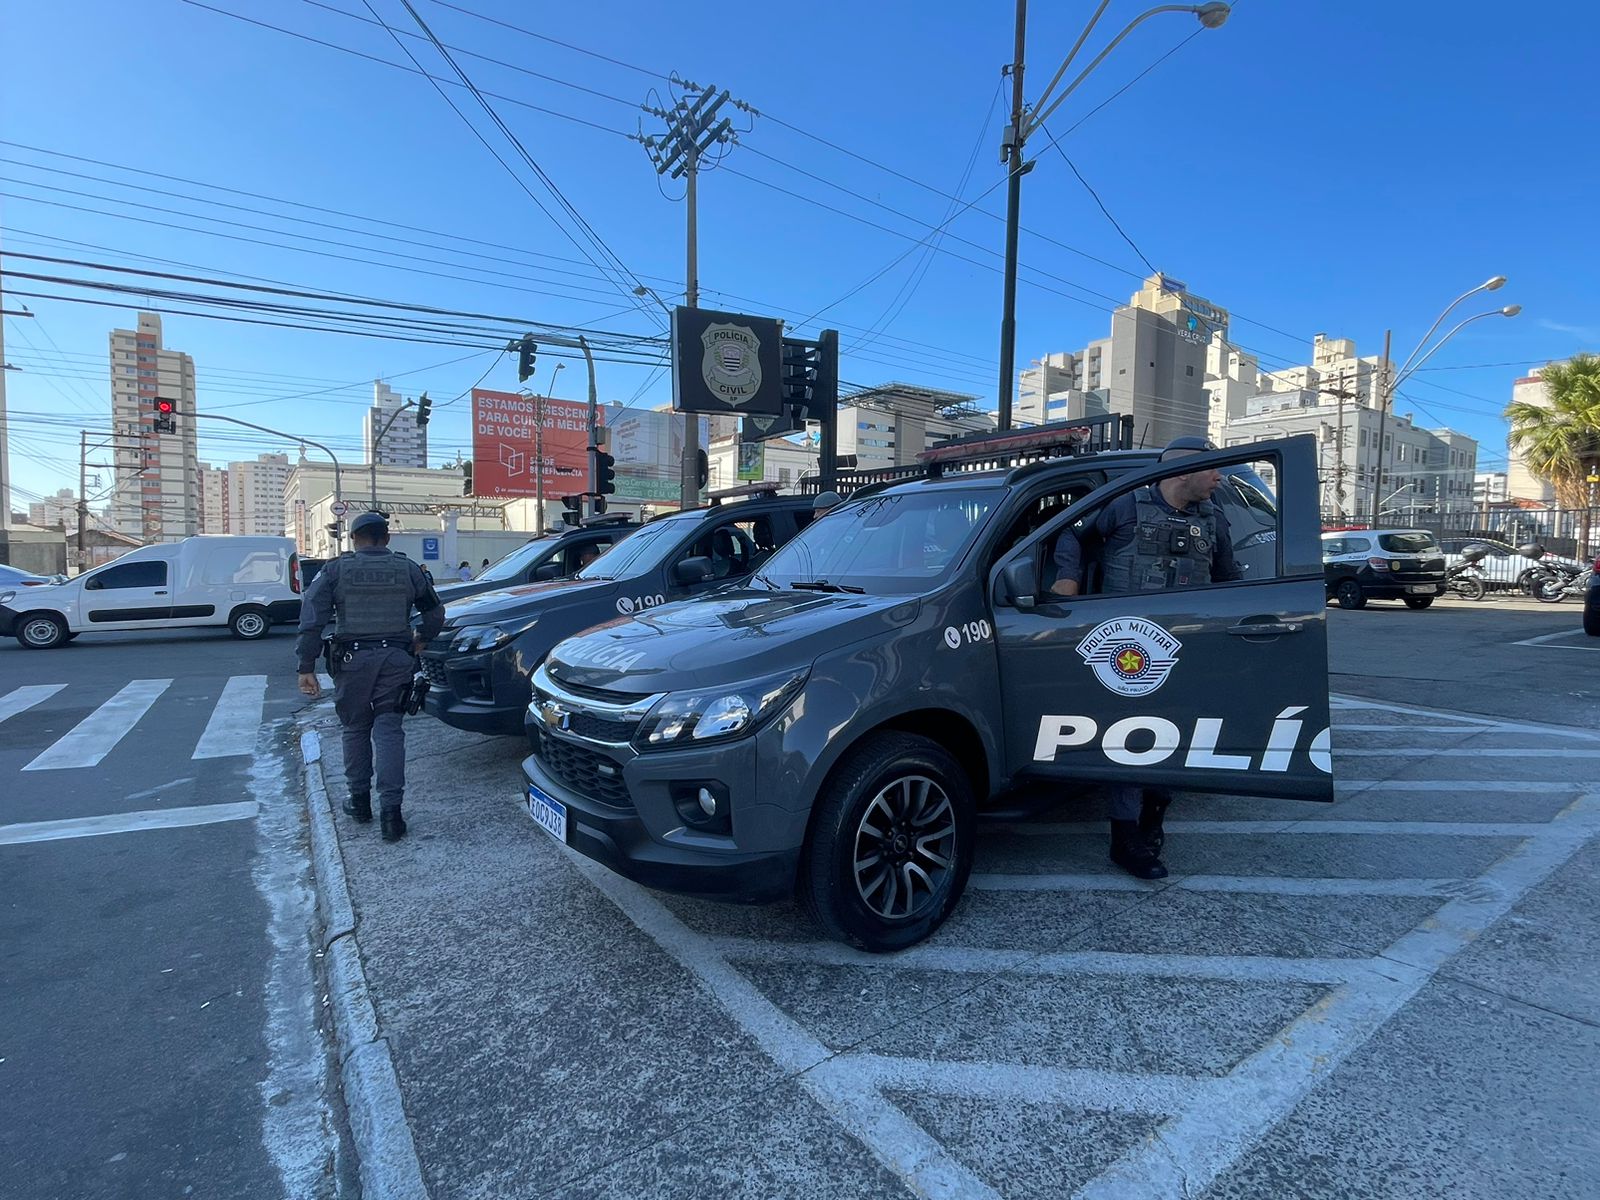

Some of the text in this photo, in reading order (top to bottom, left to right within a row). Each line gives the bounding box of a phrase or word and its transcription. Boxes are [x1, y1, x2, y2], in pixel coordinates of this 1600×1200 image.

[714, 330, 749, 344] POLÍCIA
[719, 384, 747, 394] CIVIL
[478, 397, 533, 413] ESTAMOS
[478, 411, 510, 425] PARA
[513, 414, 555, 429] CUIAR
[478, 425, 495, 436] DE
[635, 594, 665, 610] 190
[962, 619, 990, 644] 190
[1083, 621, 1173, 654] POLÍCIA MILITAR
